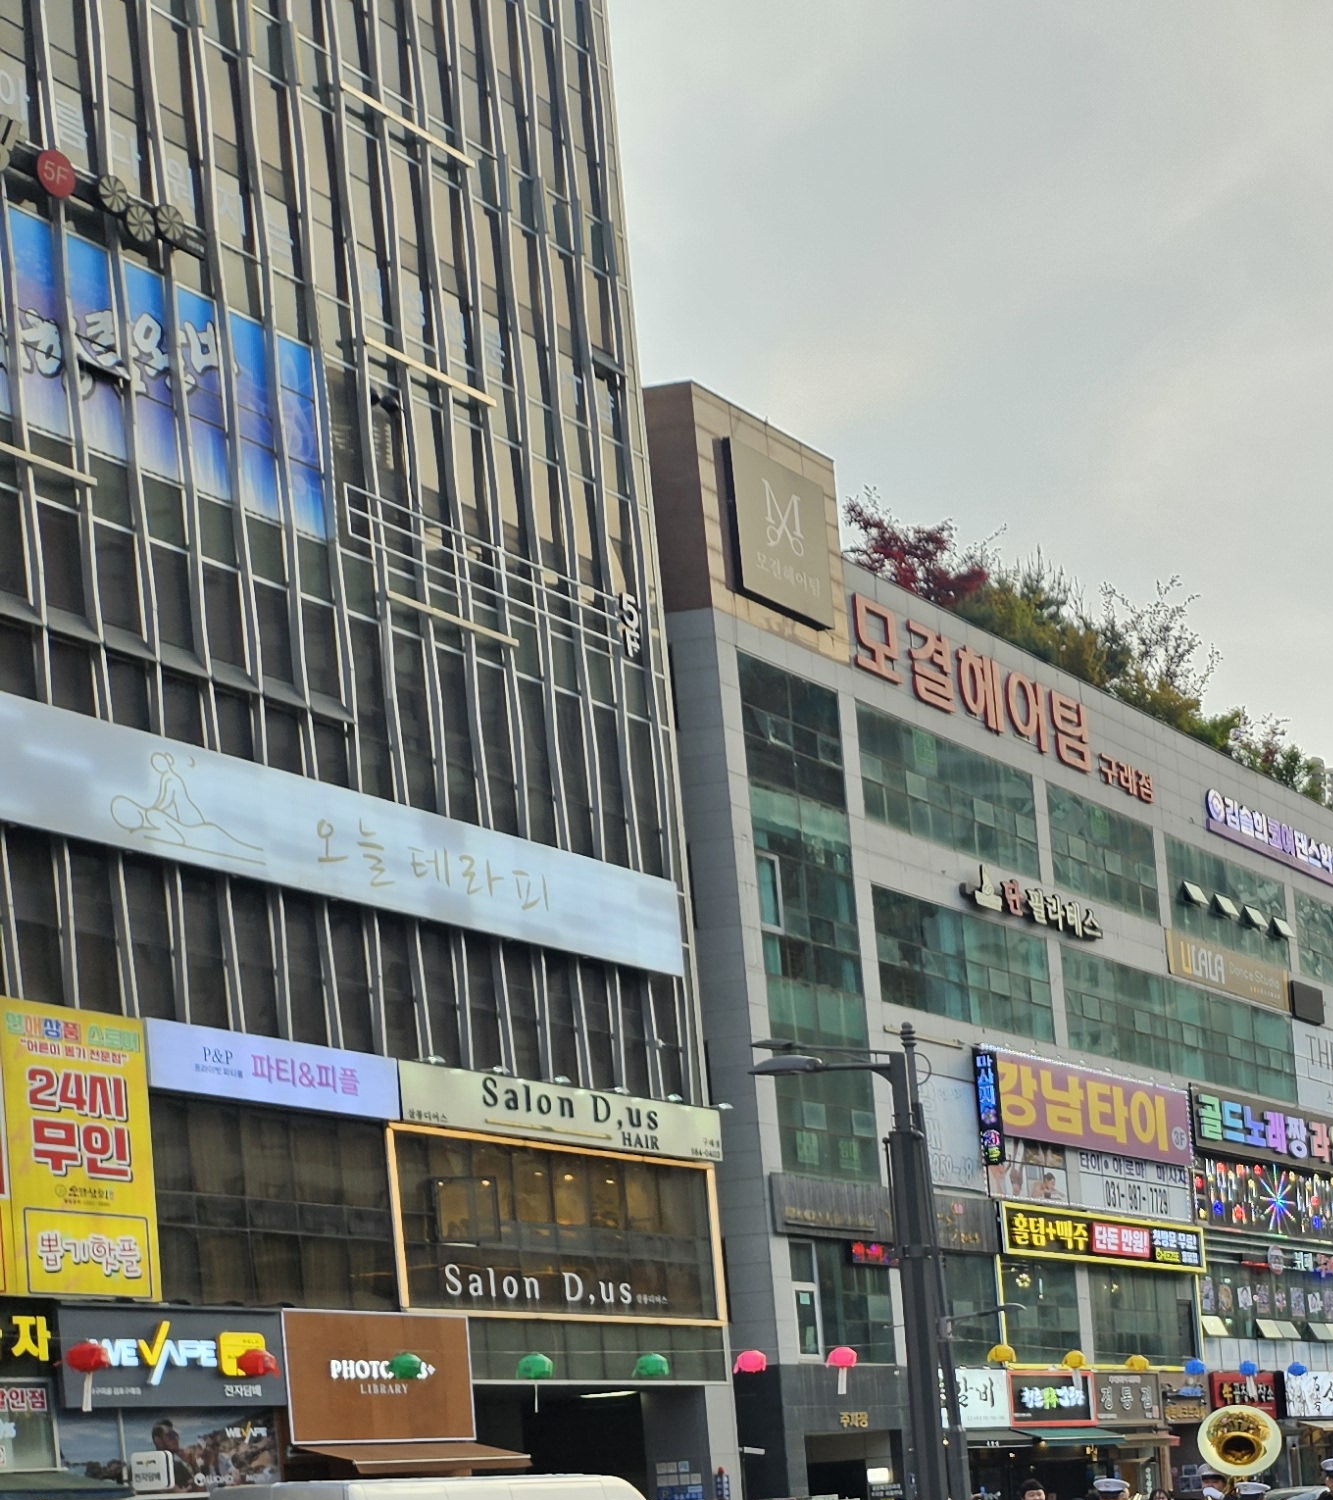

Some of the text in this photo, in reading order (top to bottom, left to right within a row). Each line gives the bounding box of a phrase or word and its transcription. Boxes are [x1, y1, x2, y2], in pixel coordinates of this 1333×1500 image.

[43, 161, 68, 187] 5F
[852, 591, 1155, 801] 모결헤어팀 구래점
[1026, 888, 1103, 938] 필라테스
[202, 1046, 234, 1066] P&P
[250, 1054, 361, 1097] 파티&피플
[27, 1067, 128, 1122] 24시
[481, 1076, 575, 1119] Salon
[998, 1061, 1185, 1152] 강남타이 3F
[32, 1118, 133, 1181] 무인
[622, 1131, 661, 1151] HAIR
[1079, 1153, 1101, 1172] 타이
[1012, 1212, 1090, 1251] 홀덤+맥주
[1094, 1224, 1120, 1250] 단돈
[444, 1263, 540, 1300] Salon
[0, 1315, 51, 1362] 자
[360, 1383, 409, 1395] LIBRARY
[839, 1411, 869, 1428] 주차장
